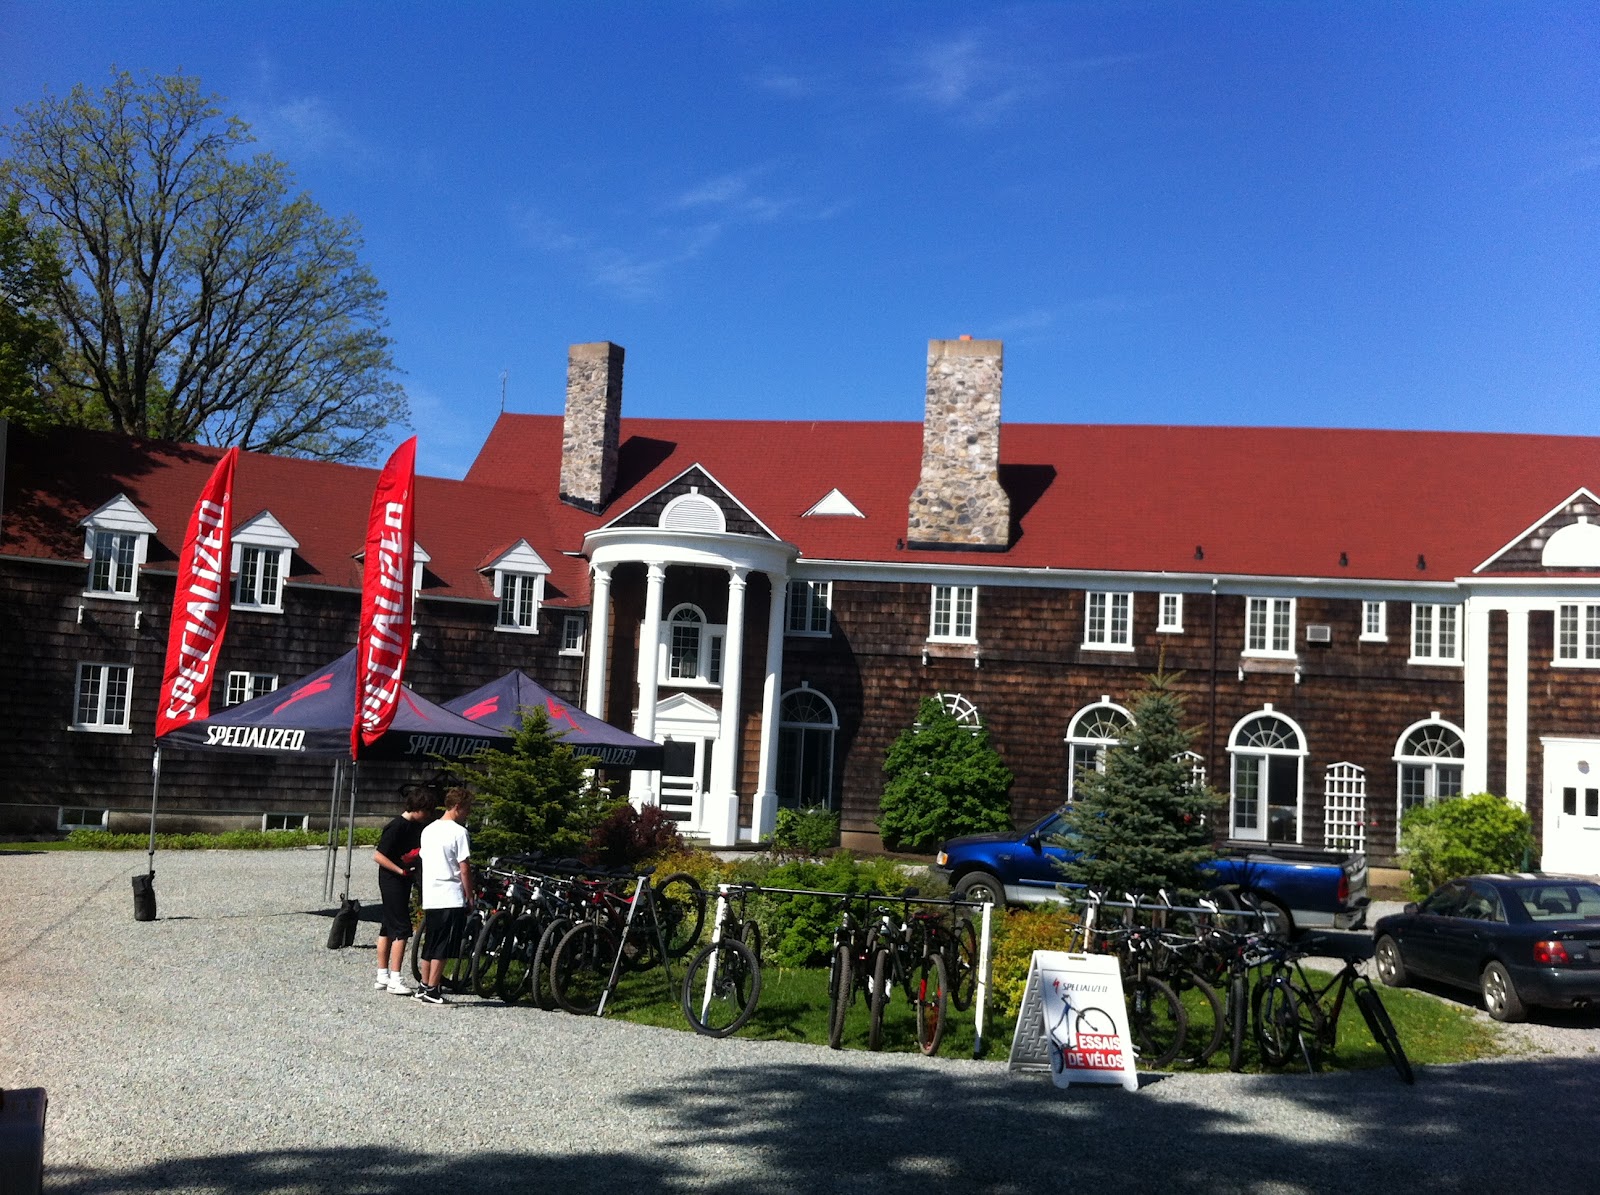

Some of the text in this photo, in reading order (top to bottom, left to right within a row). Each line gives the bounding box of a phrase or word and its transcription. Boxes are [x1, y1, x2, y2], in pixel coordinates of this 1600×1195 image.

[166, 499, 226, 720] SPECIALIZED
[203, 725, 306, 751] SPECIALIZED
[1079, 1034, 1121, 1051] ESSAIS
[1067, 1050, 1124, 1068] DE VÉLOS
